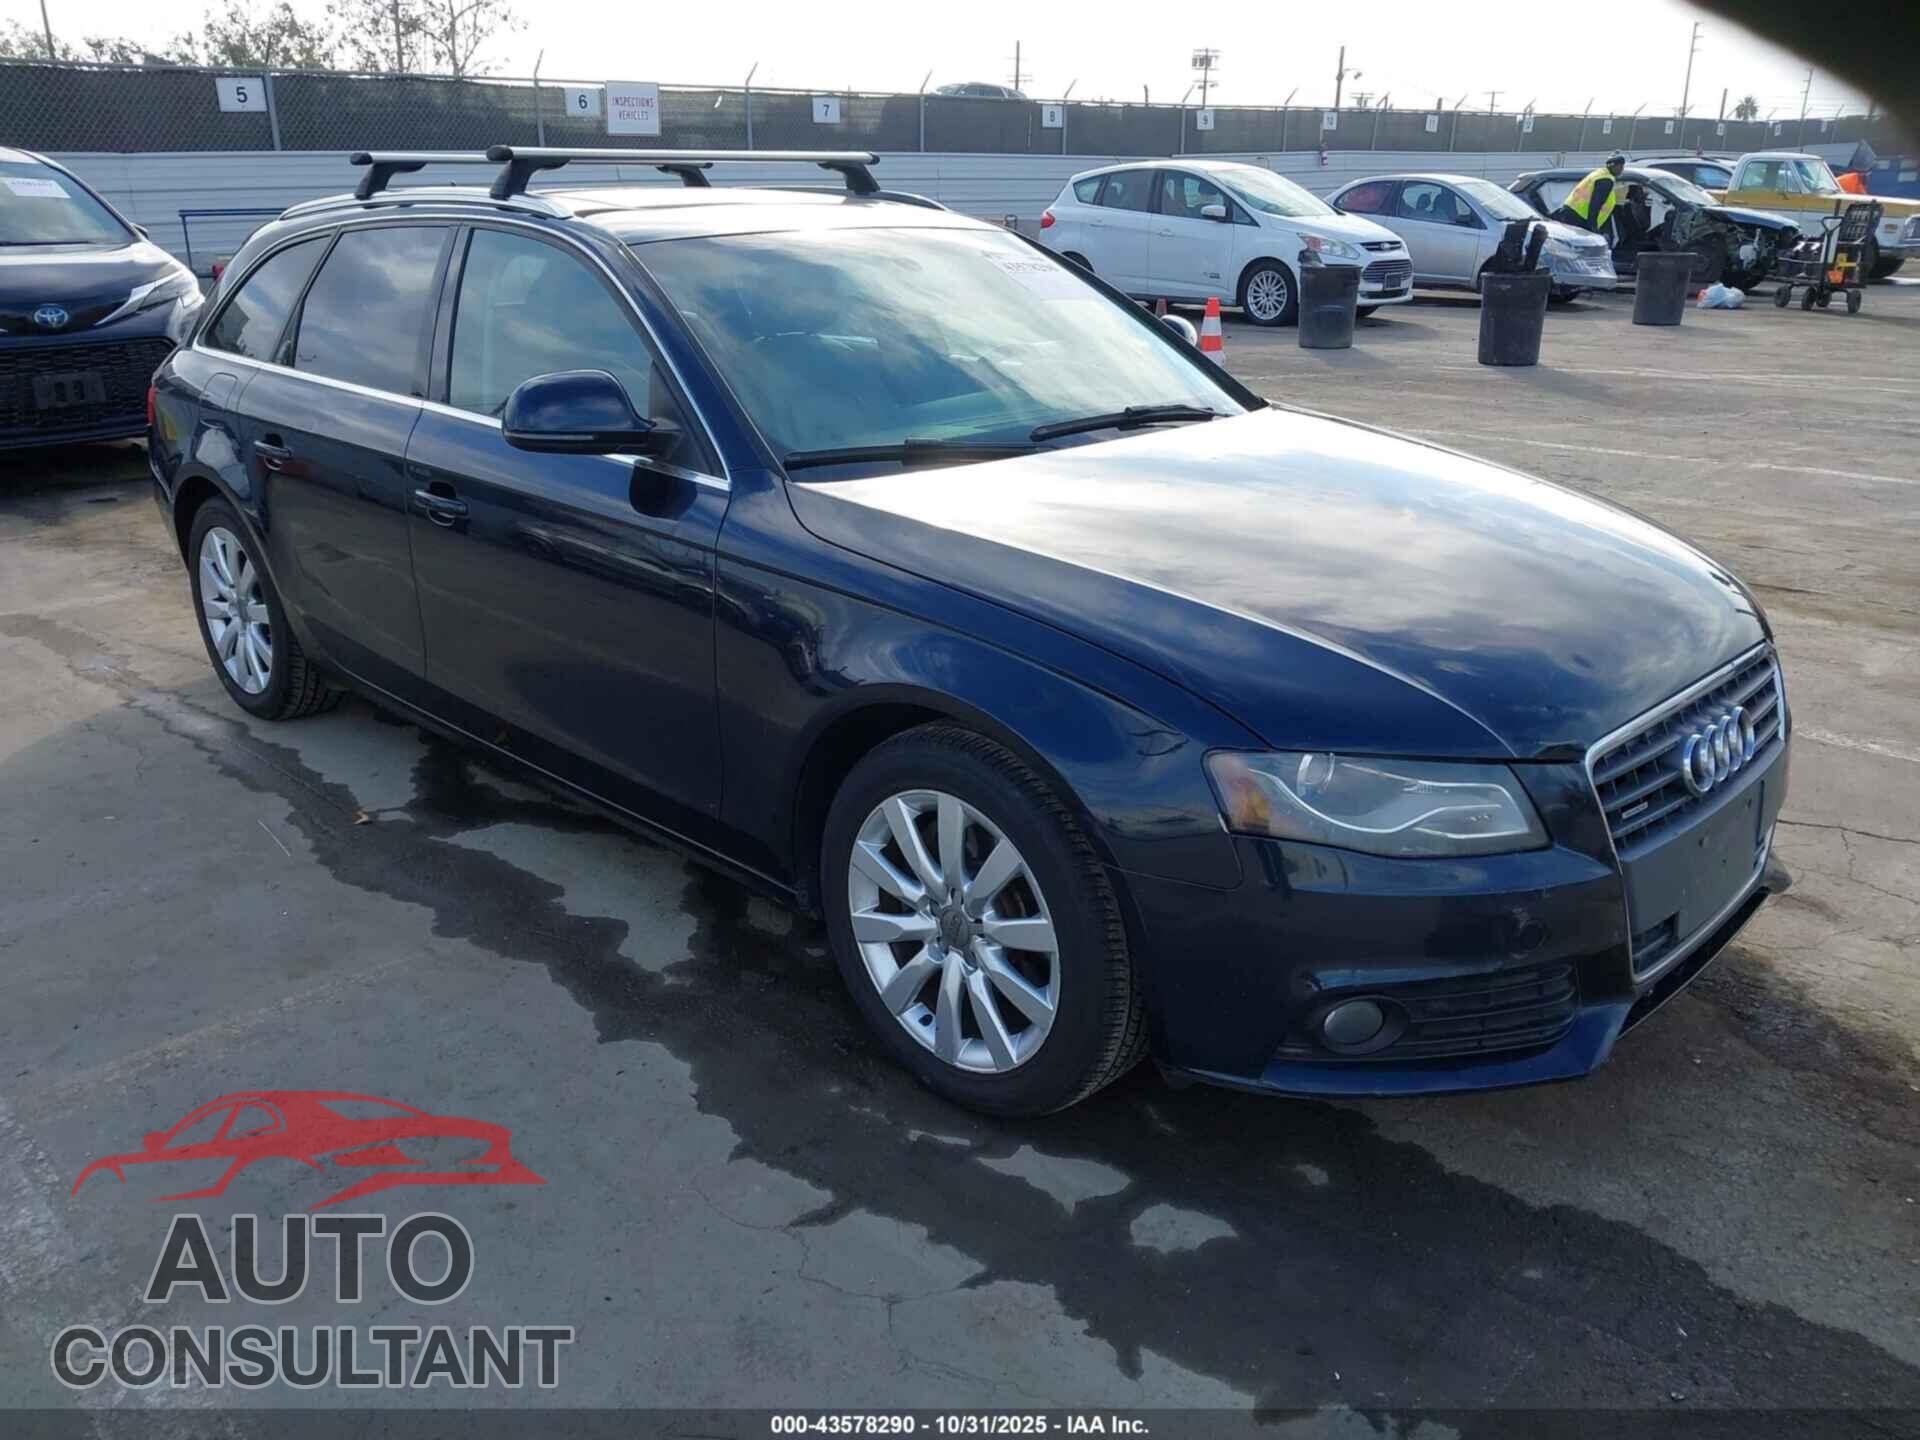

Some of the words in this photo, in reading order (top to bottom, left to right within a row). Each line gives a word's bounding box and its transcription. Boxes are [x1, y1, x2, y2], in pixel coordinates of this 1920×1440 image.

[236, 86, 248, 103] 5
[578, 94, 588, 109] 6
[612, 96, 655, 108] INSPECTIONS
[618, 110, 649, 121] VEHICLES
[823, 104, 830, 117] 7
[1049, 110, 1056, 122] 8
